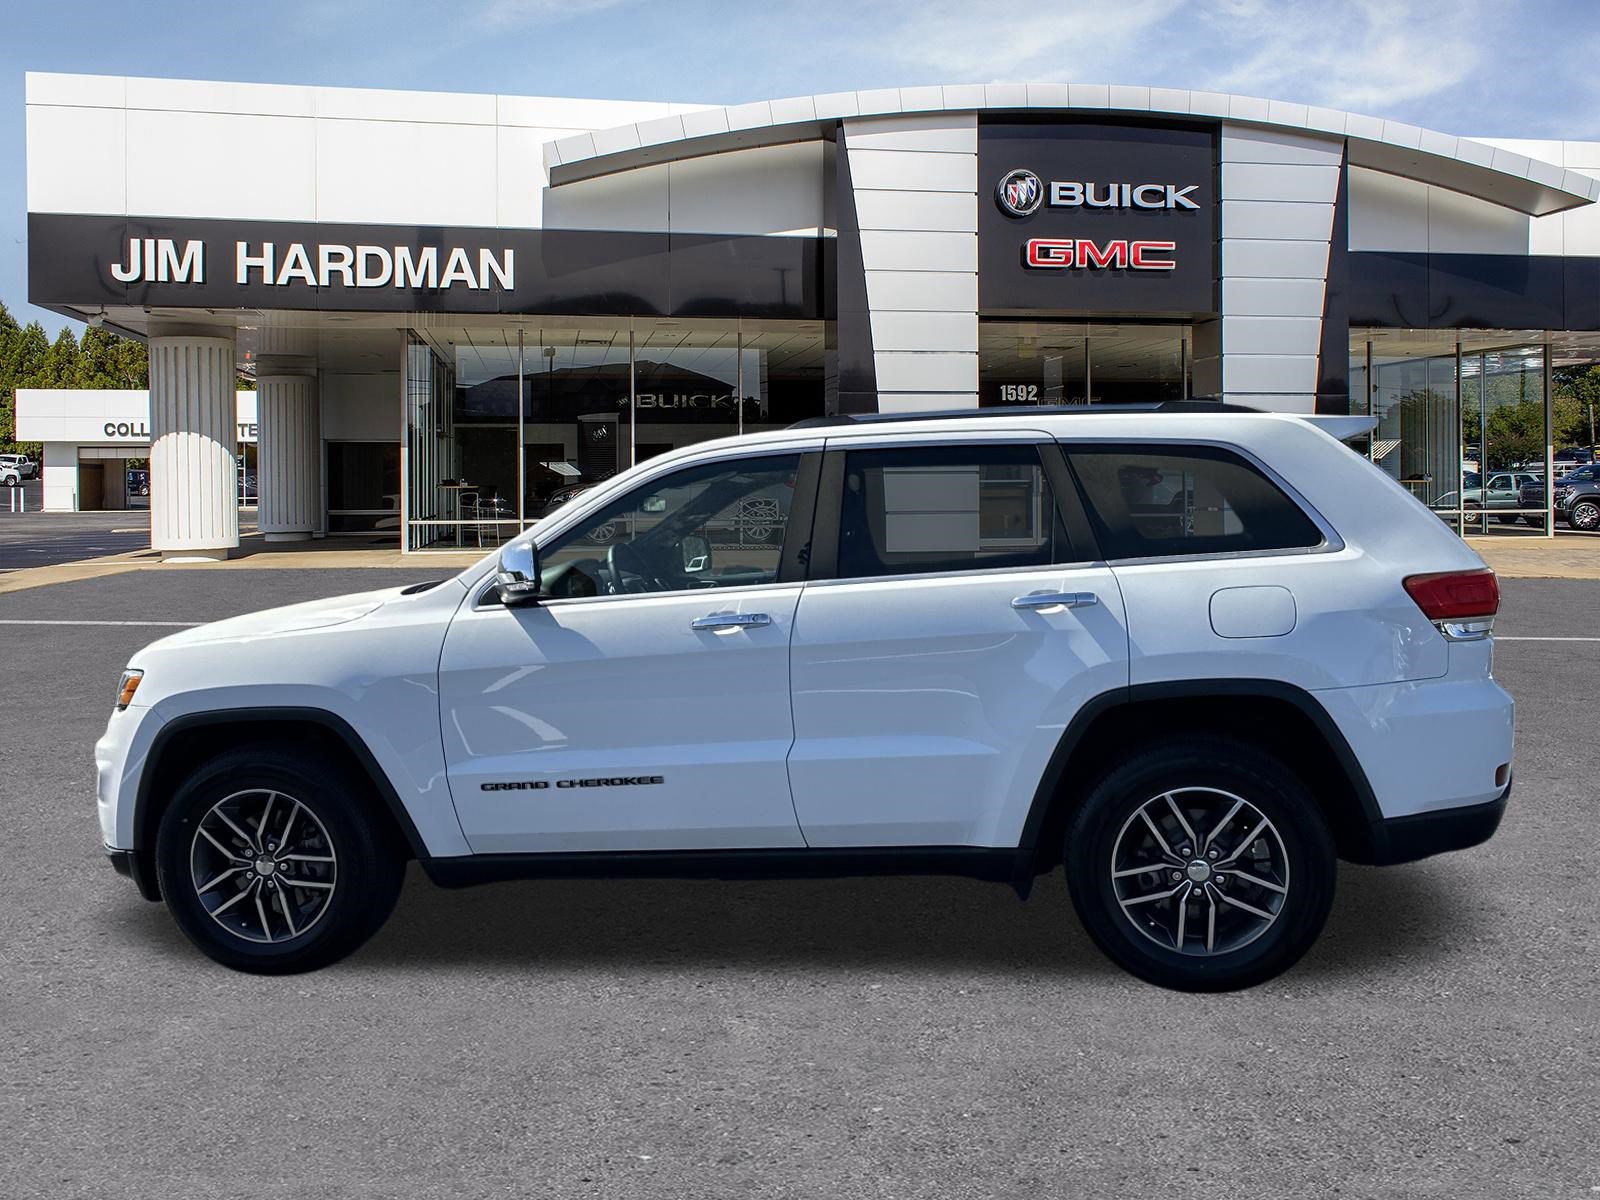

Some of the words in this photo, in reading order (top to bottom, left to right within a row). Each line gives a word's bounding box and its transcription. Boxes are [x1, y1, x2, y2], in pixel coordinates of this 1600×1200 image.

[1050, 181, 1200, 209] BUICK
[111, 238, 203, 284] JIM
[236, 241, 515, 291] HARDMAN
[1027, 238, 1176, 270] GMC
[635, 394, 732, 408] BUICK
[1000, 384, 1038, 401] 1592
[480, 781, 549, 791] GRAND
[556, 776, 665, 788] CHEROKEE
